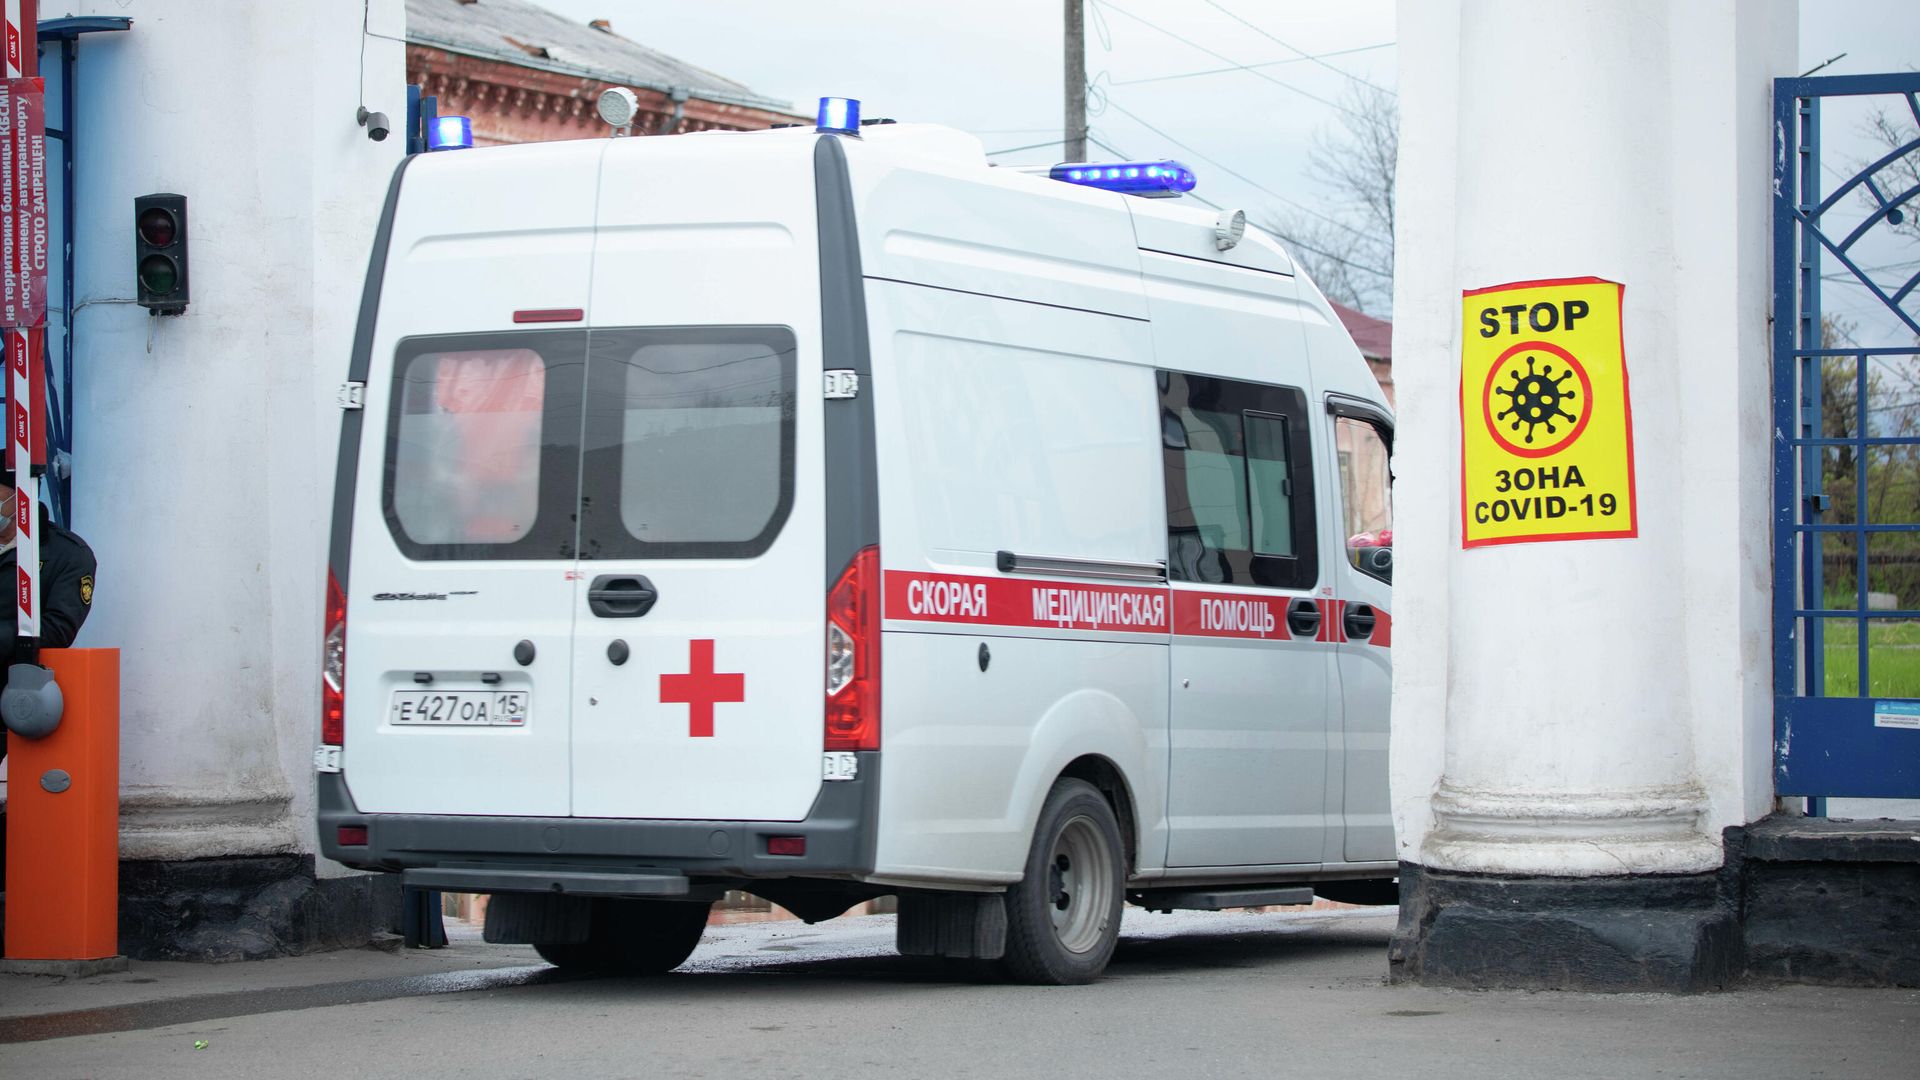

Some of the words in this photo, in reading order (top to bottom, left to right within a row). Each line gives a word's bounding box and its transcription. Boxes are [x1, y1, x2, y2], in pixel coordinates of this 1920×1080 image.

[1, 139, 12, 212] больницы
[17, 96, 30, 206] автотранспорту
[31, 135, 45, 214] ЗАПРЕЩЕН!
[4, 216, 16, 302] территорию
[20, 210, 32, 309] постороннему
[34, 217, 45, 270] СТРОГО
[6, 304, 15, 321] на
[1480, 300, 1589, 338] STOP
[1495, 465, 1585, 492] ЗОНА
[1475, 493, 1617, 524] COVID-19
[907, 580, 987, 617] СКОРАЯ
[1032, 587, 1165, 629] МЕДИЦИНСКАЯ
[1200, 598, 1275, 637] ПОМОЩЬ
[498, 695, 519, 714] 15
